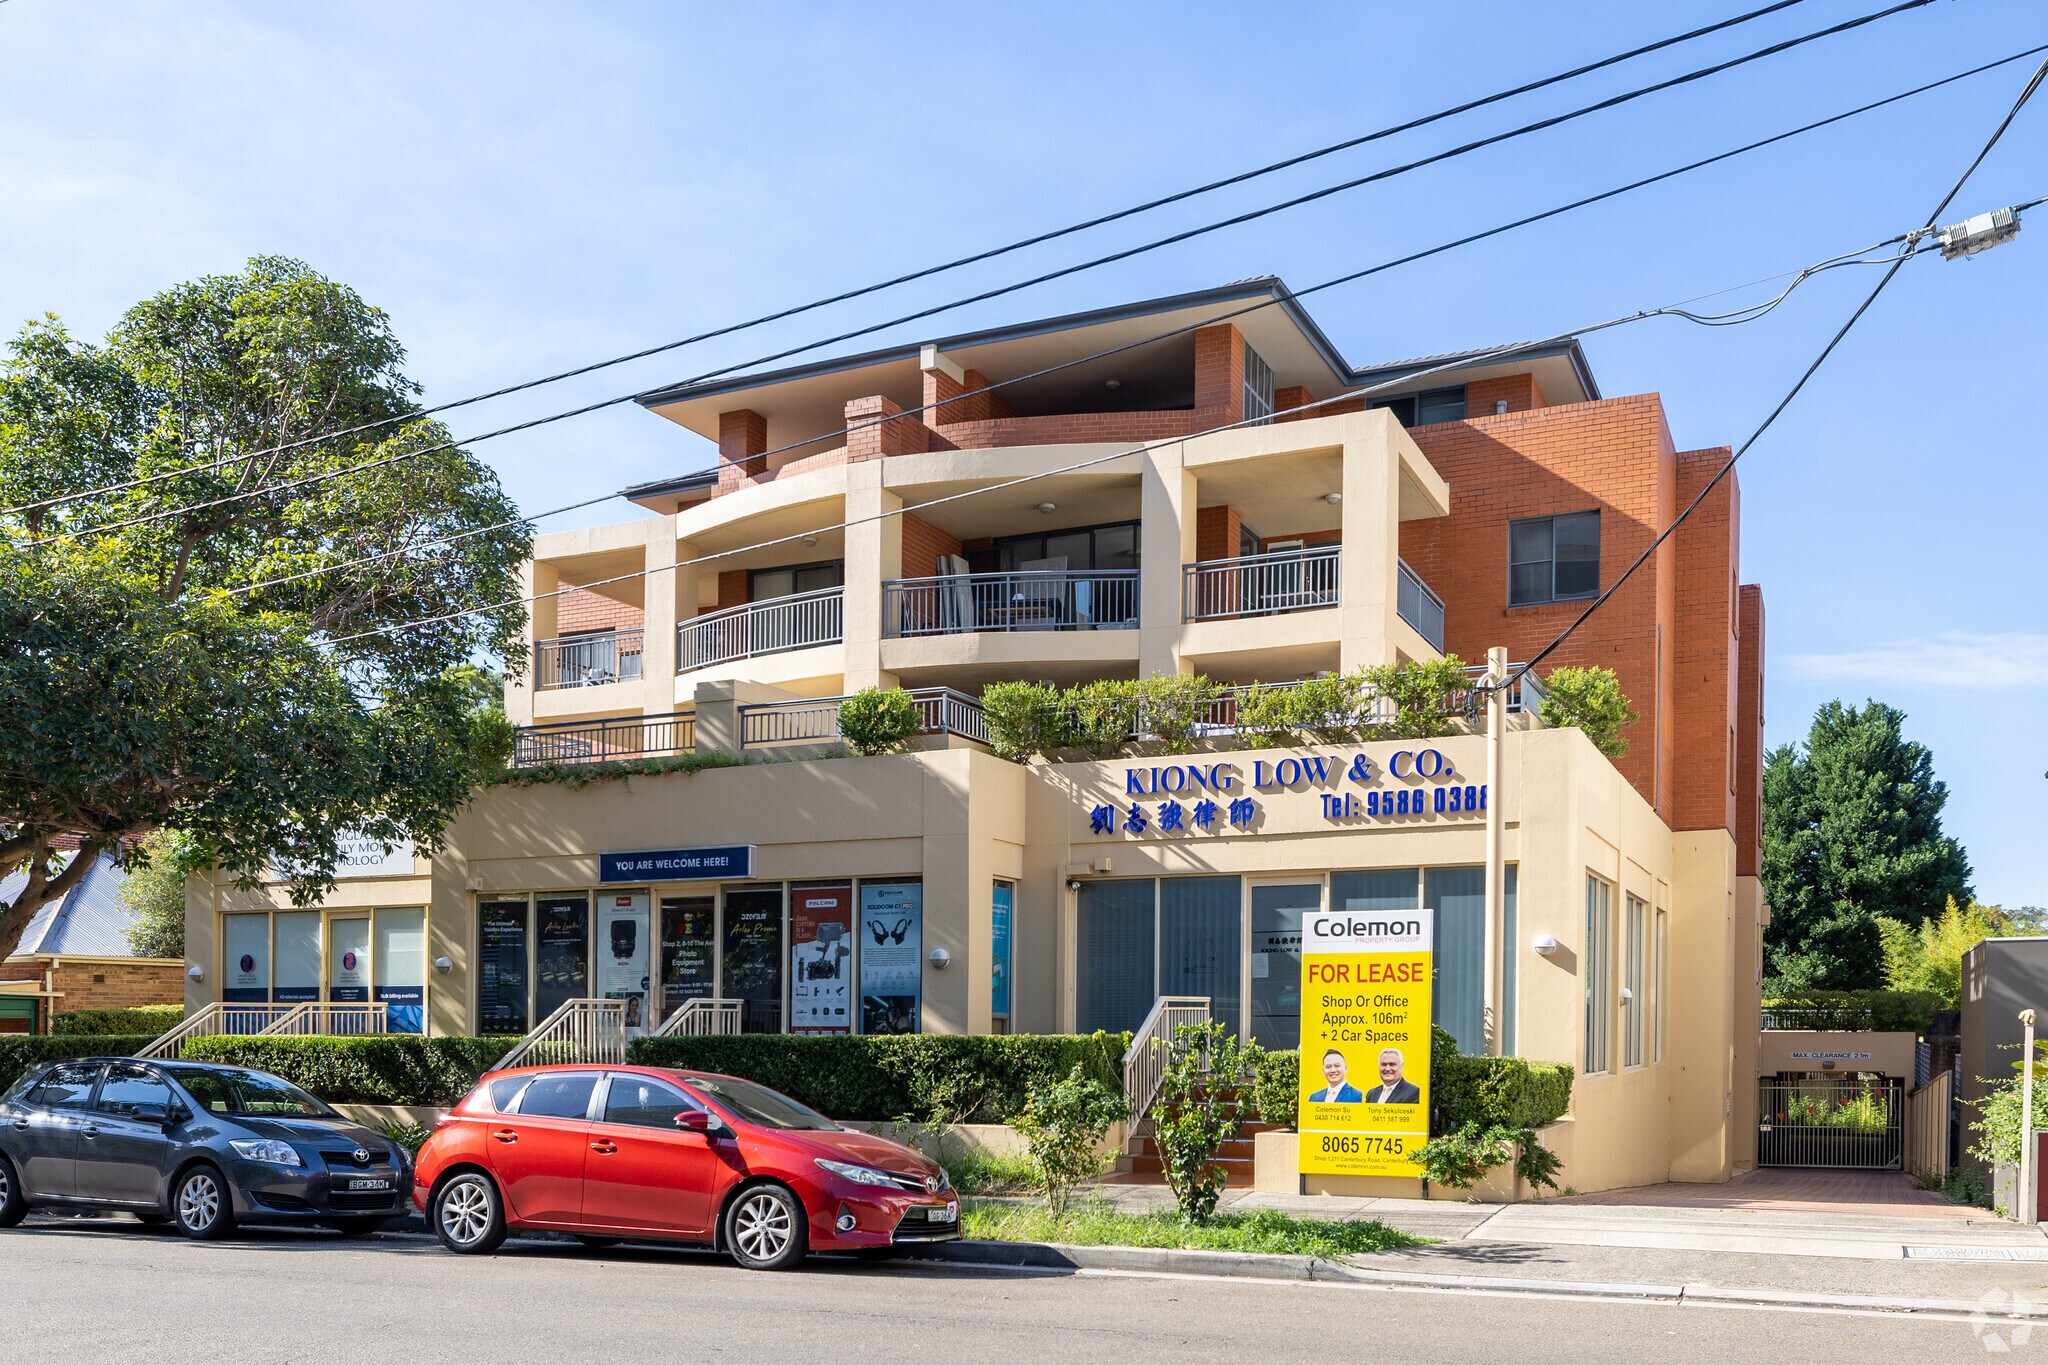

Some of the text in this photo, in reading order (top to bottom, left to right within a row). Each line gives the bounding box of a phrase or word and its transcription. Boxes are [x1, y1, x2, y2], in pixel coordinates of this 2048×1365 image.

[1125, 749, 1453, 795] KIONG LOW & CO.
[1320, 793, 1359, 818] Tel:
[1367, 789, 1424, 816] 9586
[616, 857, 729, 871] YOU ARE WELCOME HERE!
[1314, 918, 1421, 937] Colemon
[672, 959, 705, 967] Equipment
[1309, 963, 1424, 983] FOR LEASE
[1322, 995, 1409, 1010] Shop Or Office
[1322, 1012, 1368, 1027] Approx.
[1331, 1029, 1338, 1041] 2
[1341, 1029, 1362, 1041] Car
[1365, 1029, 1409, 1044] Spaces
[1368, 1107, 1382, 1115] Tony
[1322, 1136, 1403, 1154] 8065 7745
